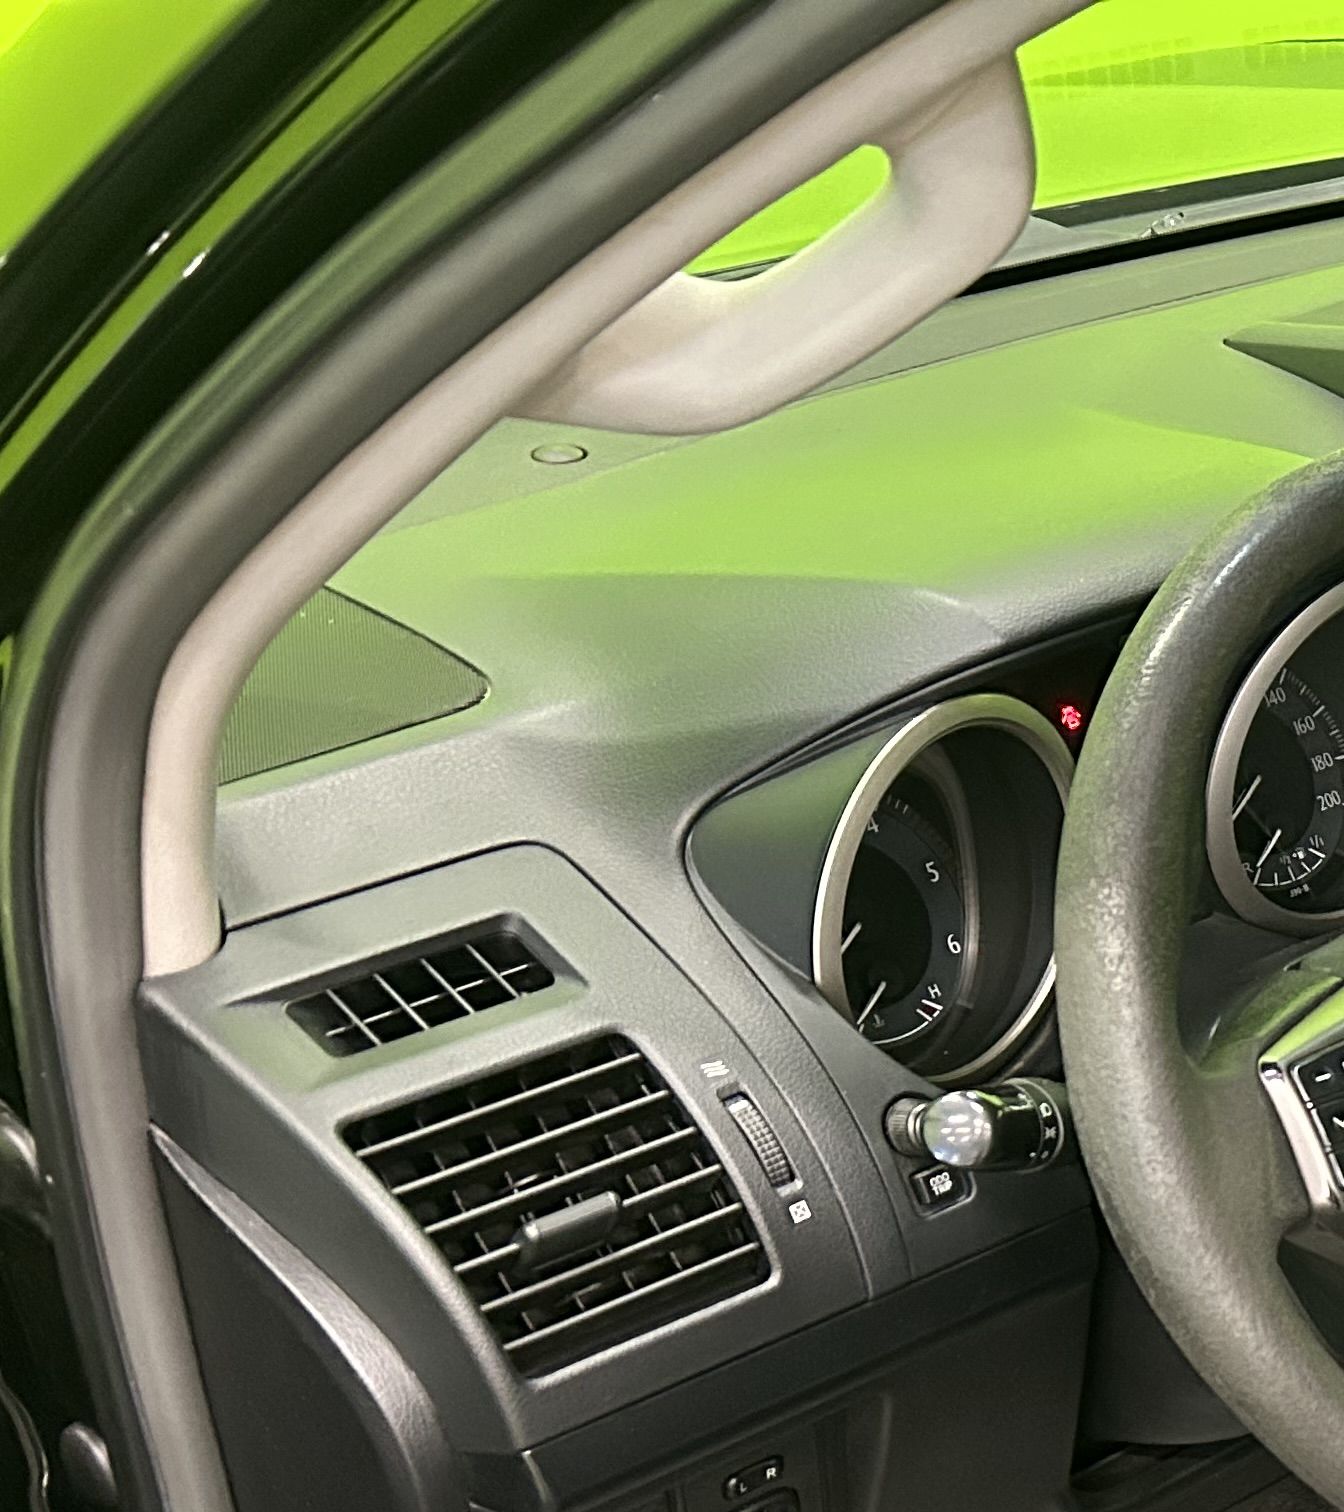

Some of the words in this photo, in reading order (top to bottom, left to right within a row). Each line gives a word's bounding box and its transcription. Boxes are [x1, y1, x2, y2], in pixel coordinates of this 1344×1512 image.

[1263, 686, 1287, 708] 140
[1294, 715, 1315, 736] 160
[1311, 751, 1335, 772] 180
[1316, 789, 1342, 812] 200
[925, 861, 940, 883] 5
[947, 933, 962, 954] 6
[927, 983, 942, 999] H
[766, 1467, 777, 1479] R
